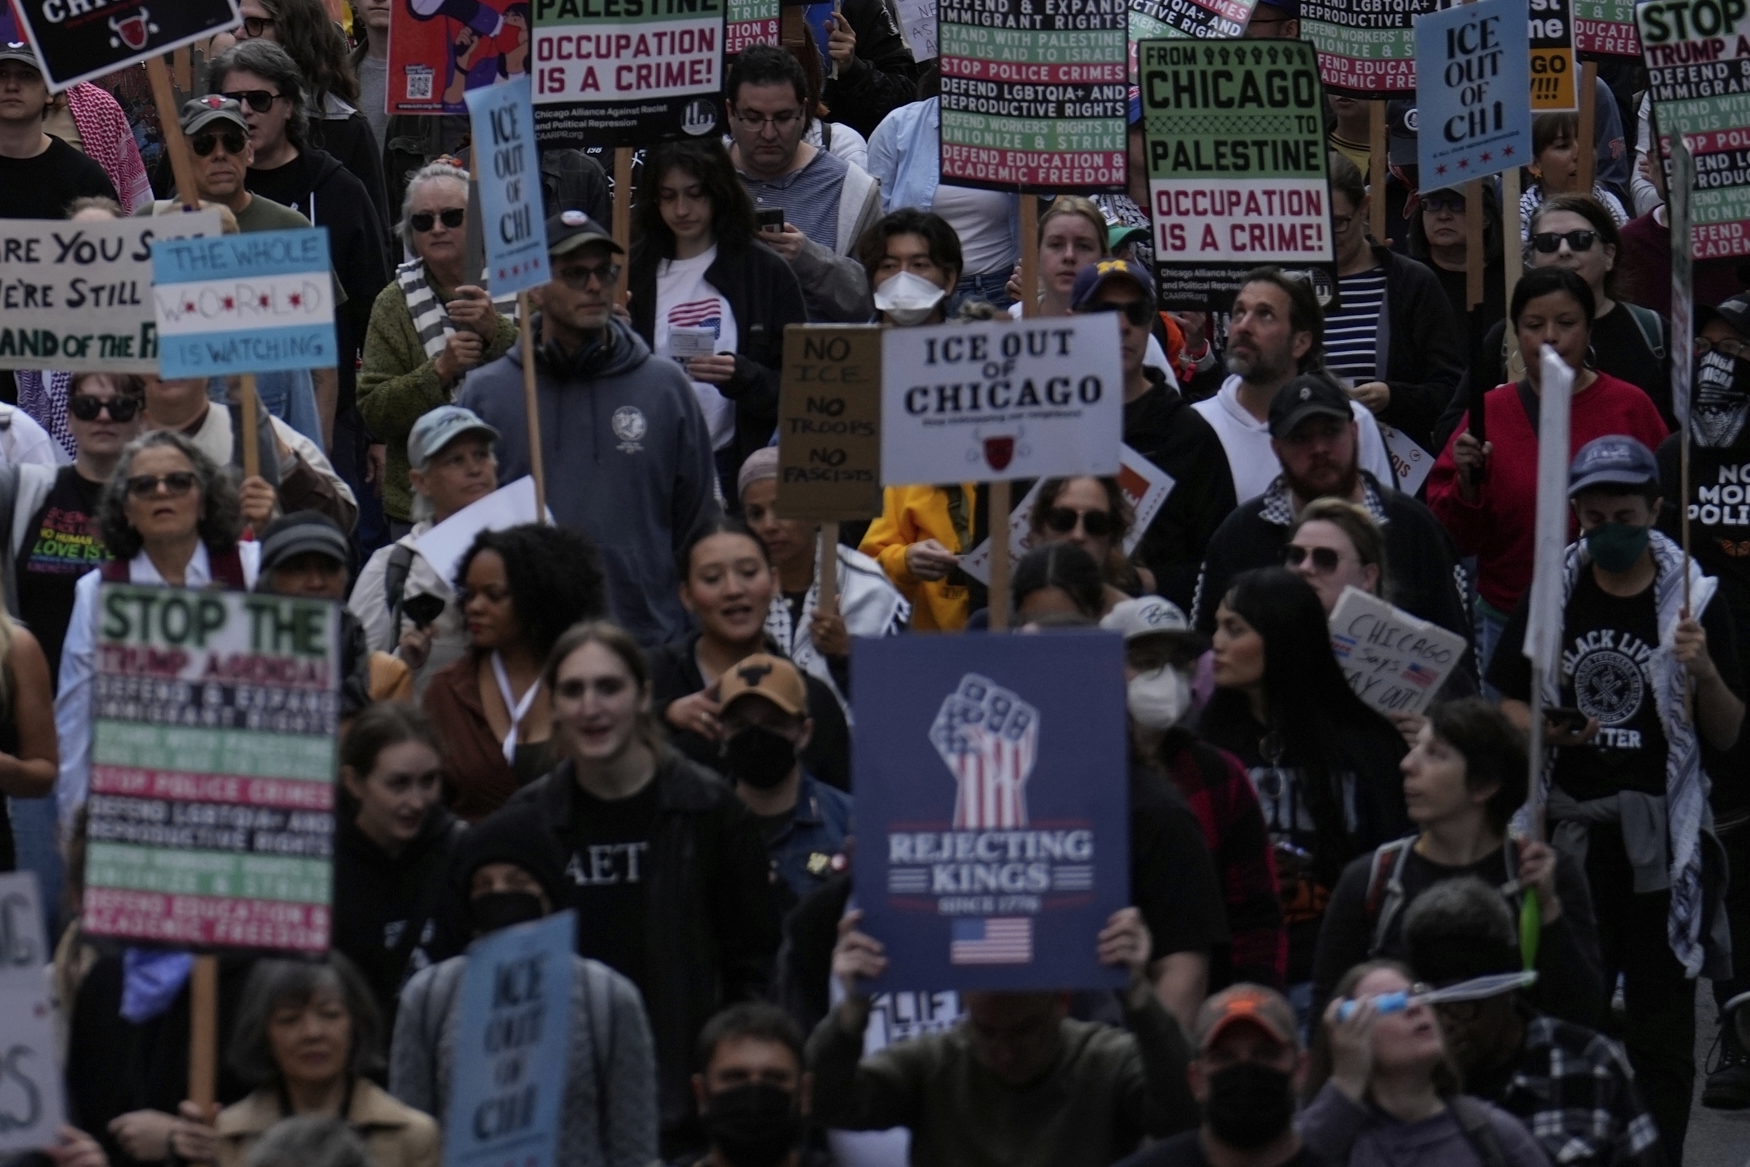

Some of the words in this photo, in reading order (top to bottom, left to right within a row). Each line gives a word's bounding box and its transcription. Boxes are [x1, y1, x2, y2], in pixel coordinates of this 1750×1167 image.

[536, 27, 715, 62] OCCUPATION
[1446, 16, 1501, 60] ICE
[537, 67, 565, 95] IS
[579, 66, 600, 92] A
[615, 58, 712, 91] CRIME!
[1443, 50, 1504, 88] OUT
[1460, 81, 1490, 107] OF
[534, 110, 568, 120] Chicago
[570, 108, 604, 117] Alliance
[606, 106, 640, 116] Against
[641, 104, 668, 114] Racist
[534, 121, 551, 130] and
[552, 119, 587, 129] Political
[589, 118, 637, 128] Repression
[1443, 100, 1504, 143] CHI
[53, 230, 124, 265] YOU
[167, 246, 227, 271] THE
[234, 236, 321, 265] WHOLE
[65, 278, 141, 308] STILL
[62, 335, 91, 358] OF
[99, 335, 134, 358] THE
[180, 347, 203, 366] IS
[206, 336, 324, 365] WATCHING
[803, 336, 851, 362] NO
[792, 363, 870, 383] ICE
[806, 396, 845, 416] NO
[785, 418, 876, 435] TROOPS
[809, 448, 847, 466] NO
[783, 466, 873, 483] FASCISTS
[1347, 613, 1451, 664] CHICAGO
[888, 829, 1093, 864] REJECTING
[931, 863, 1051, 895] KINGS
